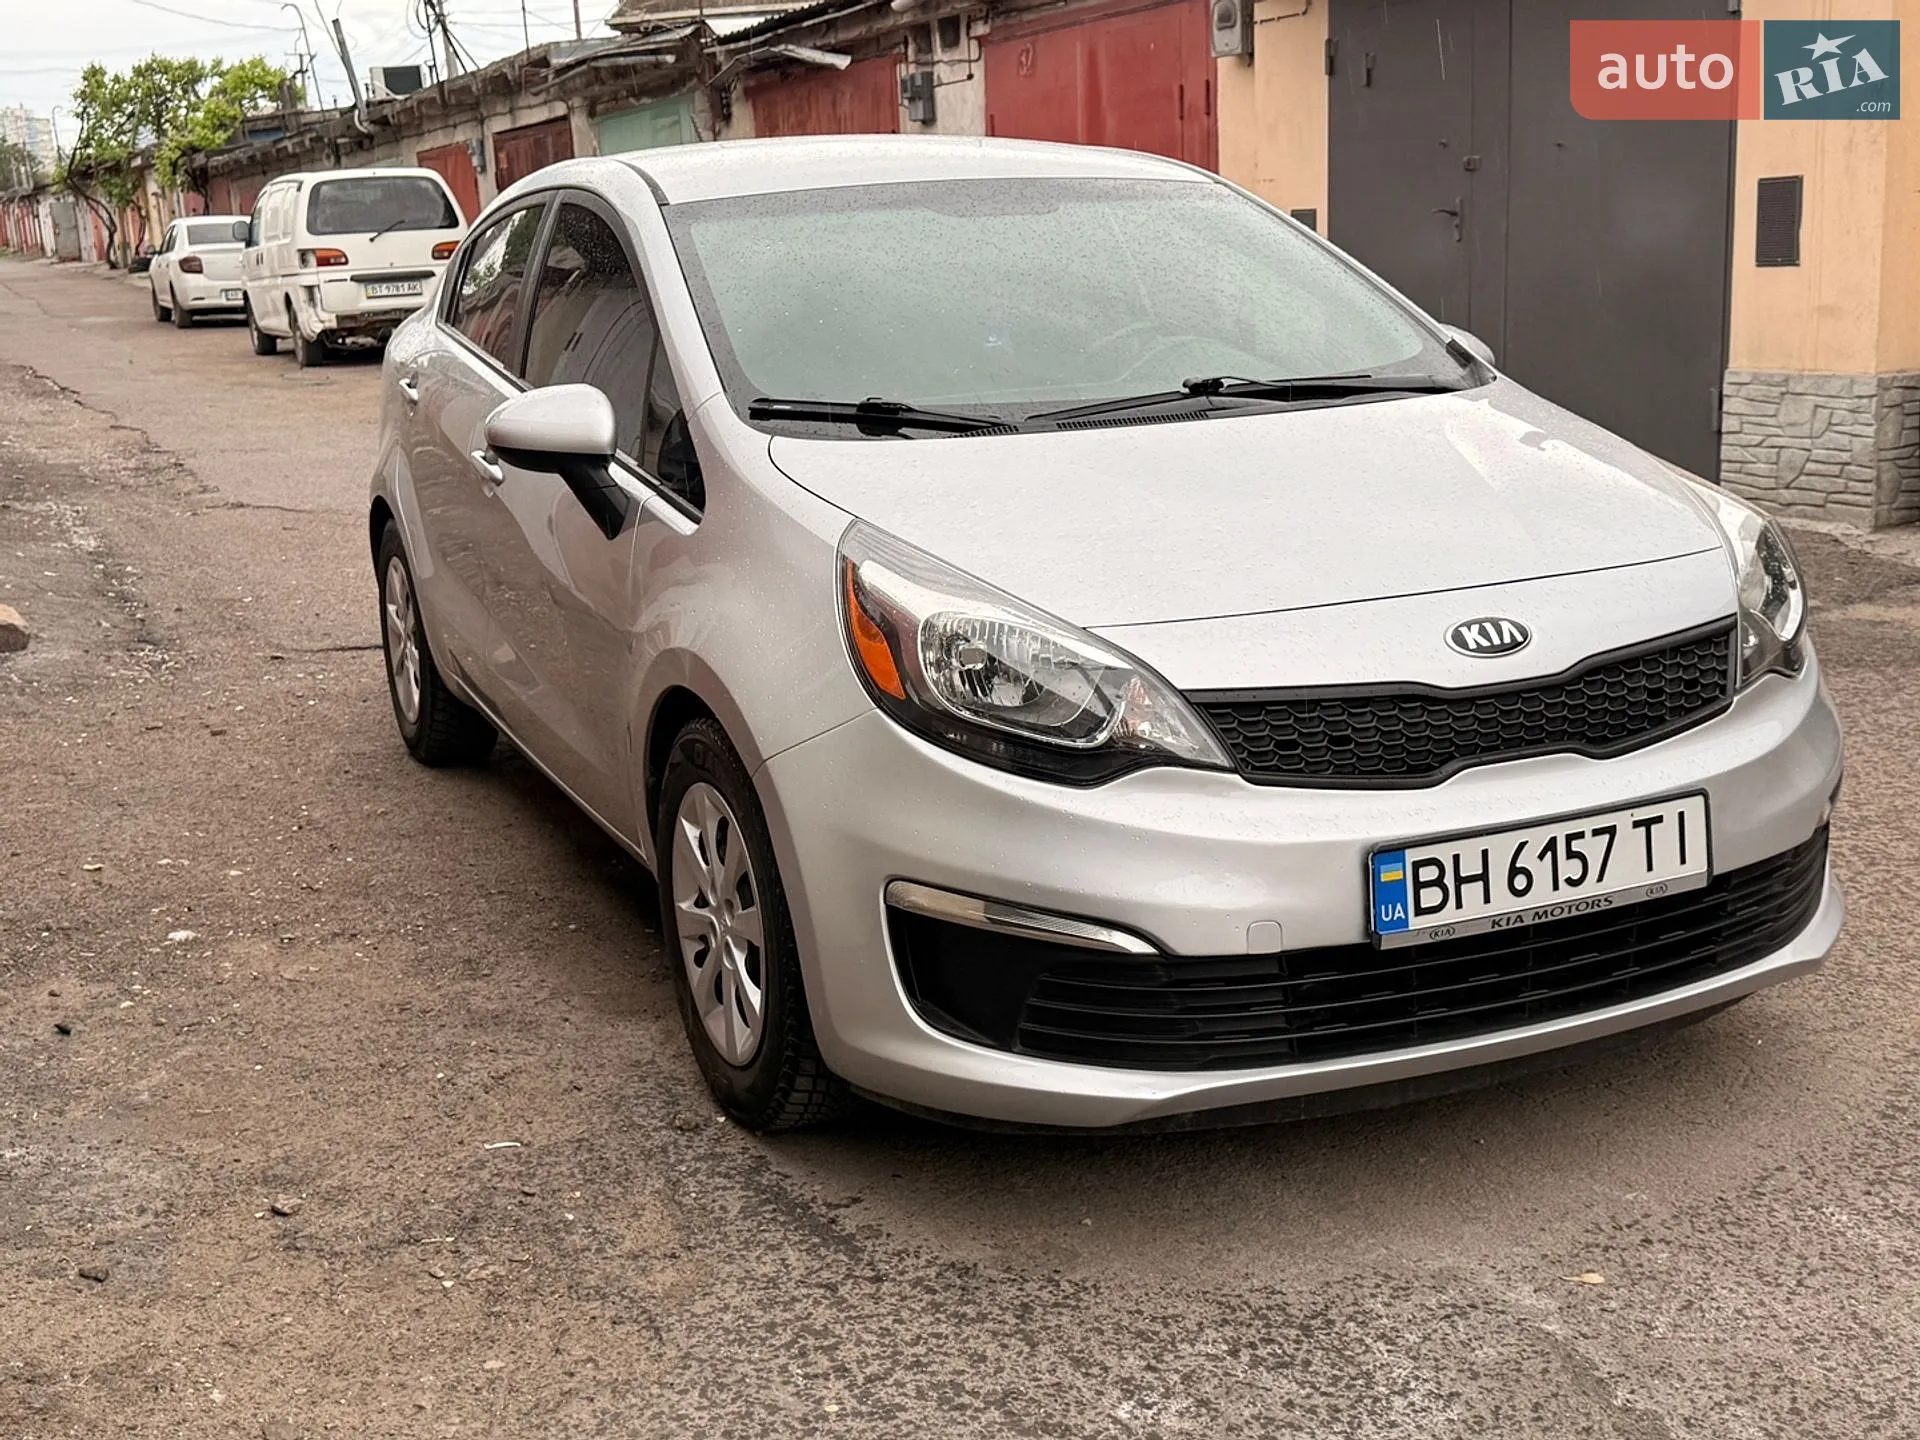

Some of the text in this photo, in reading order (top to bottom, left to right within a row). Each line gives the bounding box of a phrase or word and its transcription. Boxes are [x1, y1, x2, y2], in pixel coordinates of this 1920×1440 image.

[1458, 620, 1524, 650] KIA
[1411, 810, 1687, 918] BH 6157 TI
[1381, 902, 1406, 921] UA
[1432, 927, 1453, 938] KIA
[1490, 915, 1525, 929] KIA
[1532, 896, 1614, 922] MOTORS
